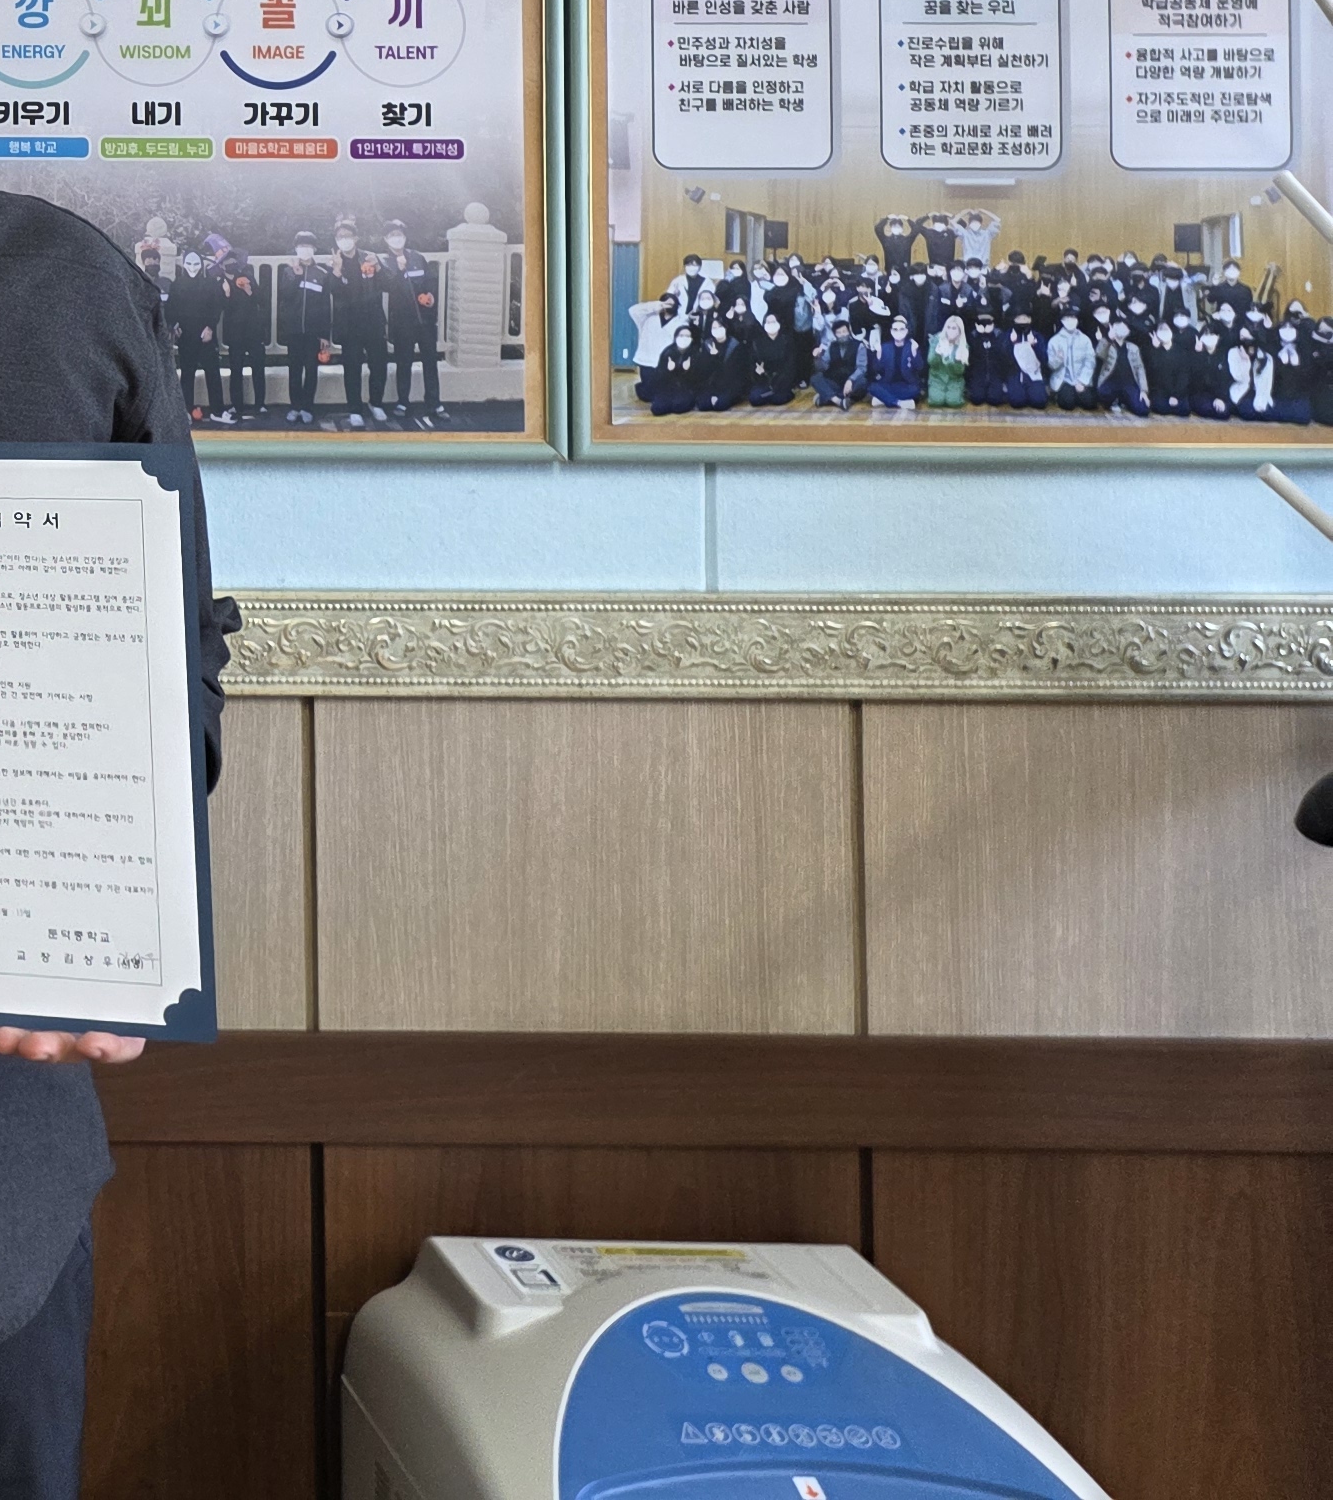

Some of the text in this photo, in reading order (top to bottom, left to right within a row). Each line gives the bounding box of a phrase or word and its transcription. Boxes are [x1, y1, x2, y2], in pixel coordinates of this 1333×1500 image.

[2, 45, 65, 58] ENERGY
[120, 45, 191, 59] WISDOM
[253, 45, 304, 59] IMAGE
[375, 46, 438, 59] TALENT
[132, 101, 181, 126] 내기
[244, 102, 318, 126] 가꾸기
[382, 102, 431, 126] 찾기
